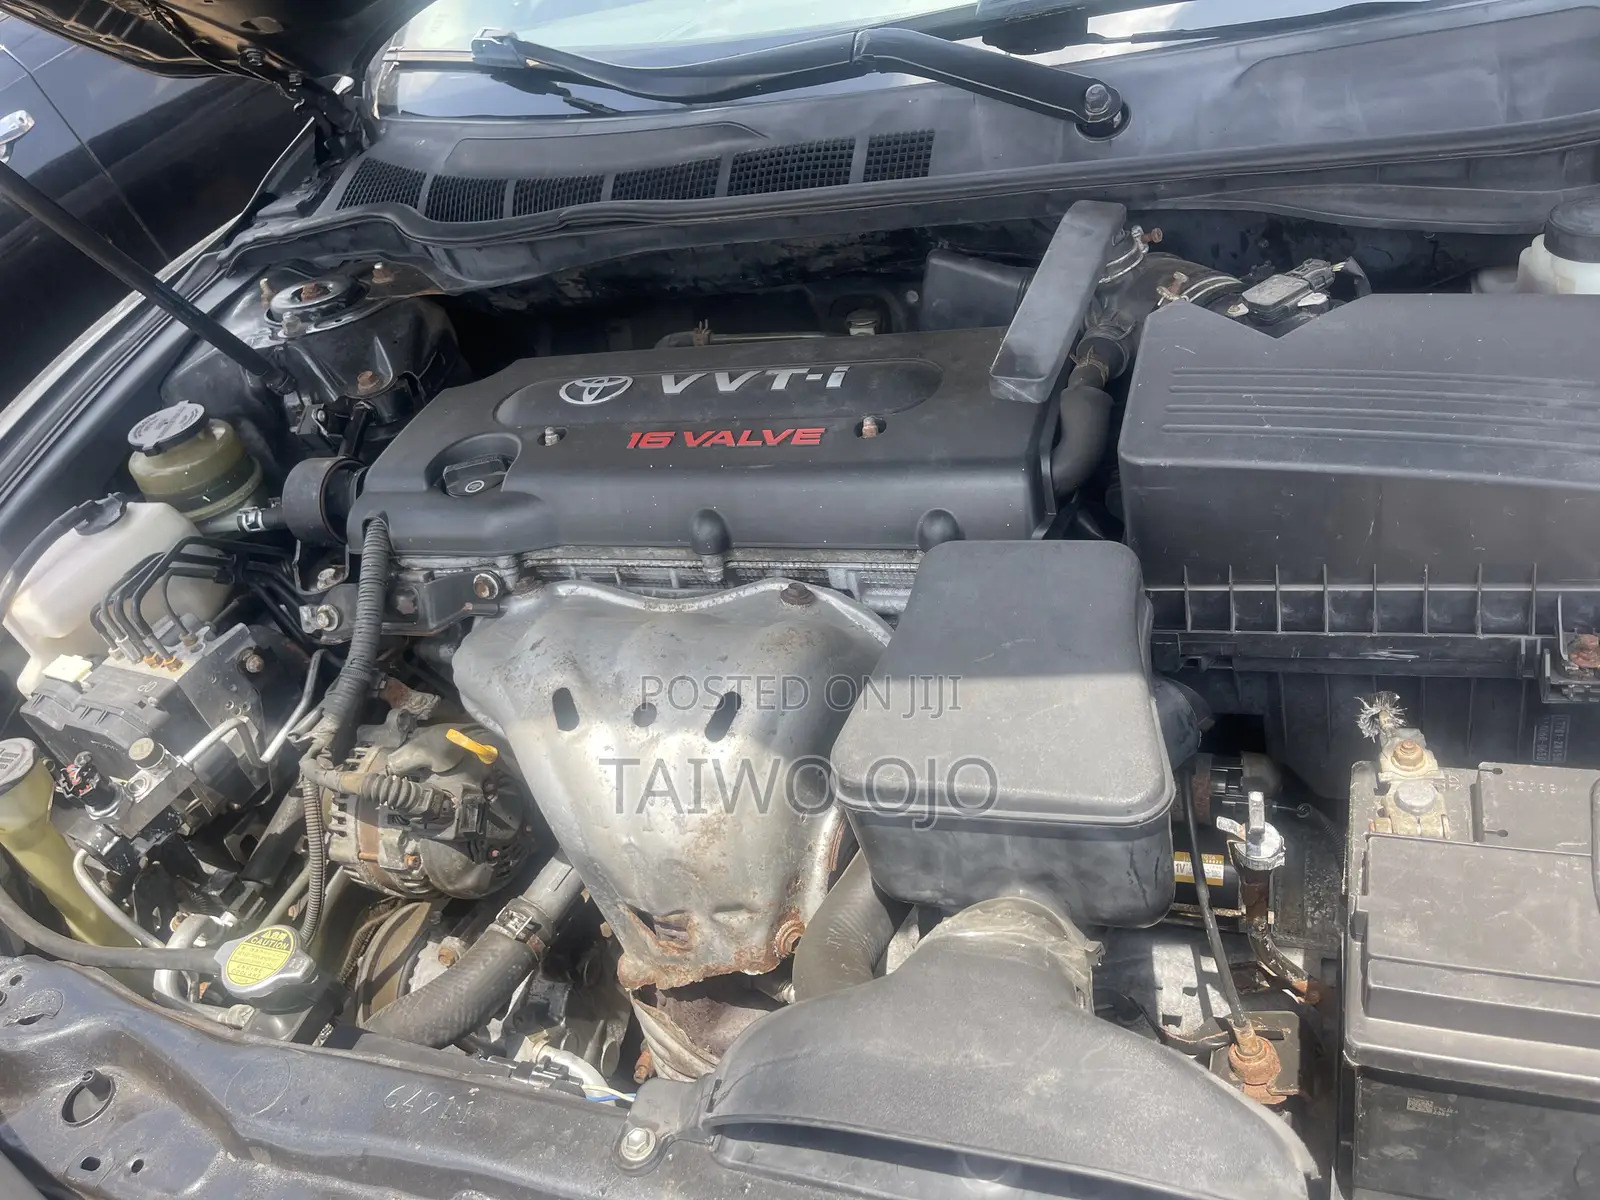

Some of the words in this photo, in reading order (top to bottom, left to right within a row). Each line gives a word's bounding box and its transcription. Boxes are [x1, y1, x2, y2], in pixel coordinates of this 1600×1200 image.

[661, 366, 850, 394] VVT-i
[626, 431, 676, 449] 16
[683, 427, 826, 447] VALVE
[250, 937, 290, 950] CAUTION
[230, 968, 263, 979] COOLANT
